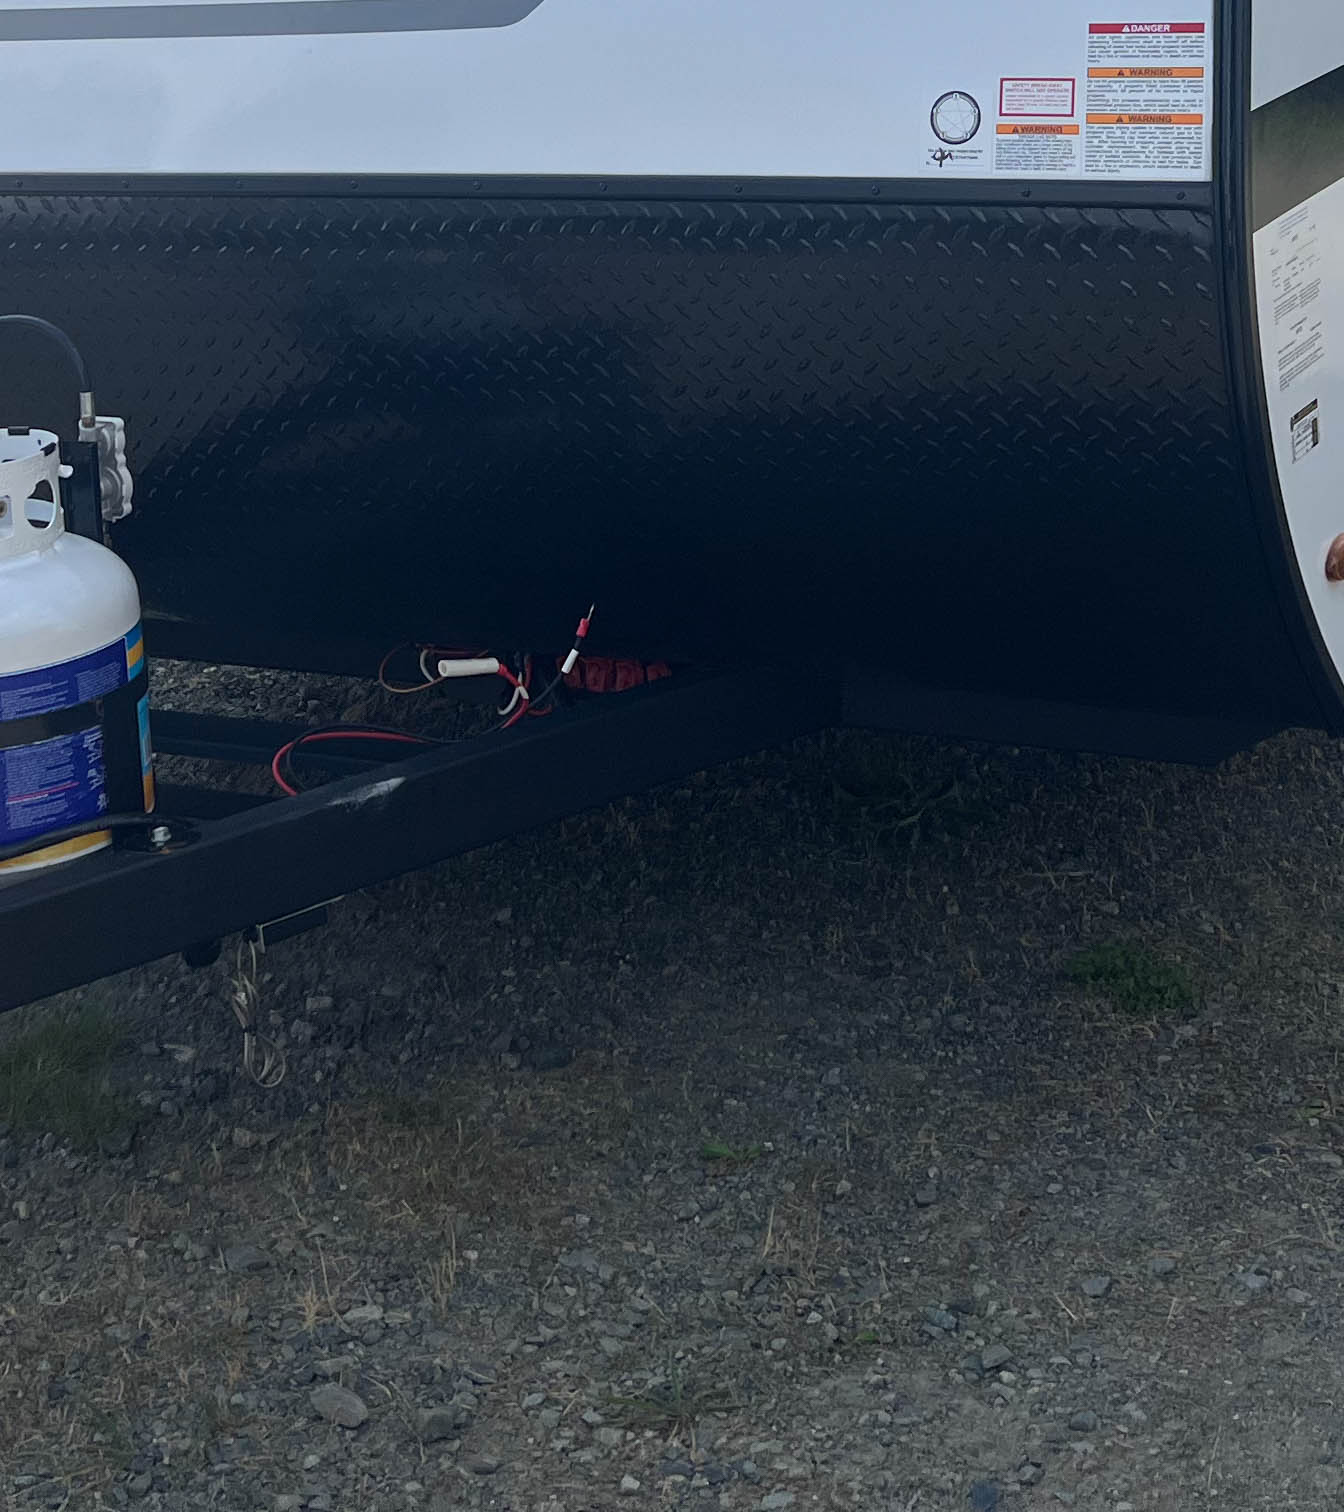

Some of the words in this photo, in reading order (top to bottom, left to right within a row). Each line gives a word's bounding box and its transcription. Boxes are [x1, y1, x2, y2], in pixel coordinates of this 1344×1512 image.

[1130, 24, 1171, 33] DANGER
[1129, 68, 1173, 77] WARNING
[1128, 115, 1173, 123] WARNING
[1021, 126, 1063, 134] WARNING
